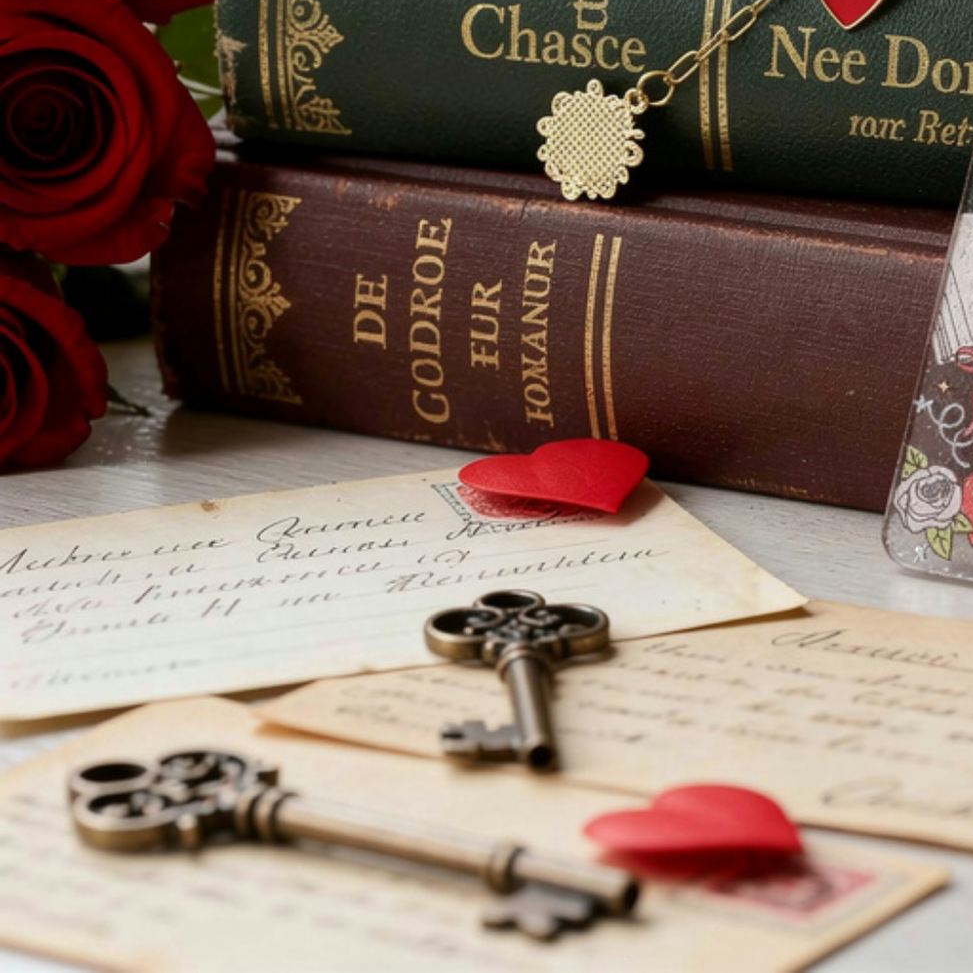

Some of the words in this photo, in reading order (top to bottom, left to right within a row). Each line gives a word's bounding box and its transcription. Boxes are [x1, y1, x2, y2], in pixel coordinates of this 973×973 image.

[460, 2, 647, 74] Chasce
[764, 25, 867, 85] Nee
[353, 274, 388, 349] DE
